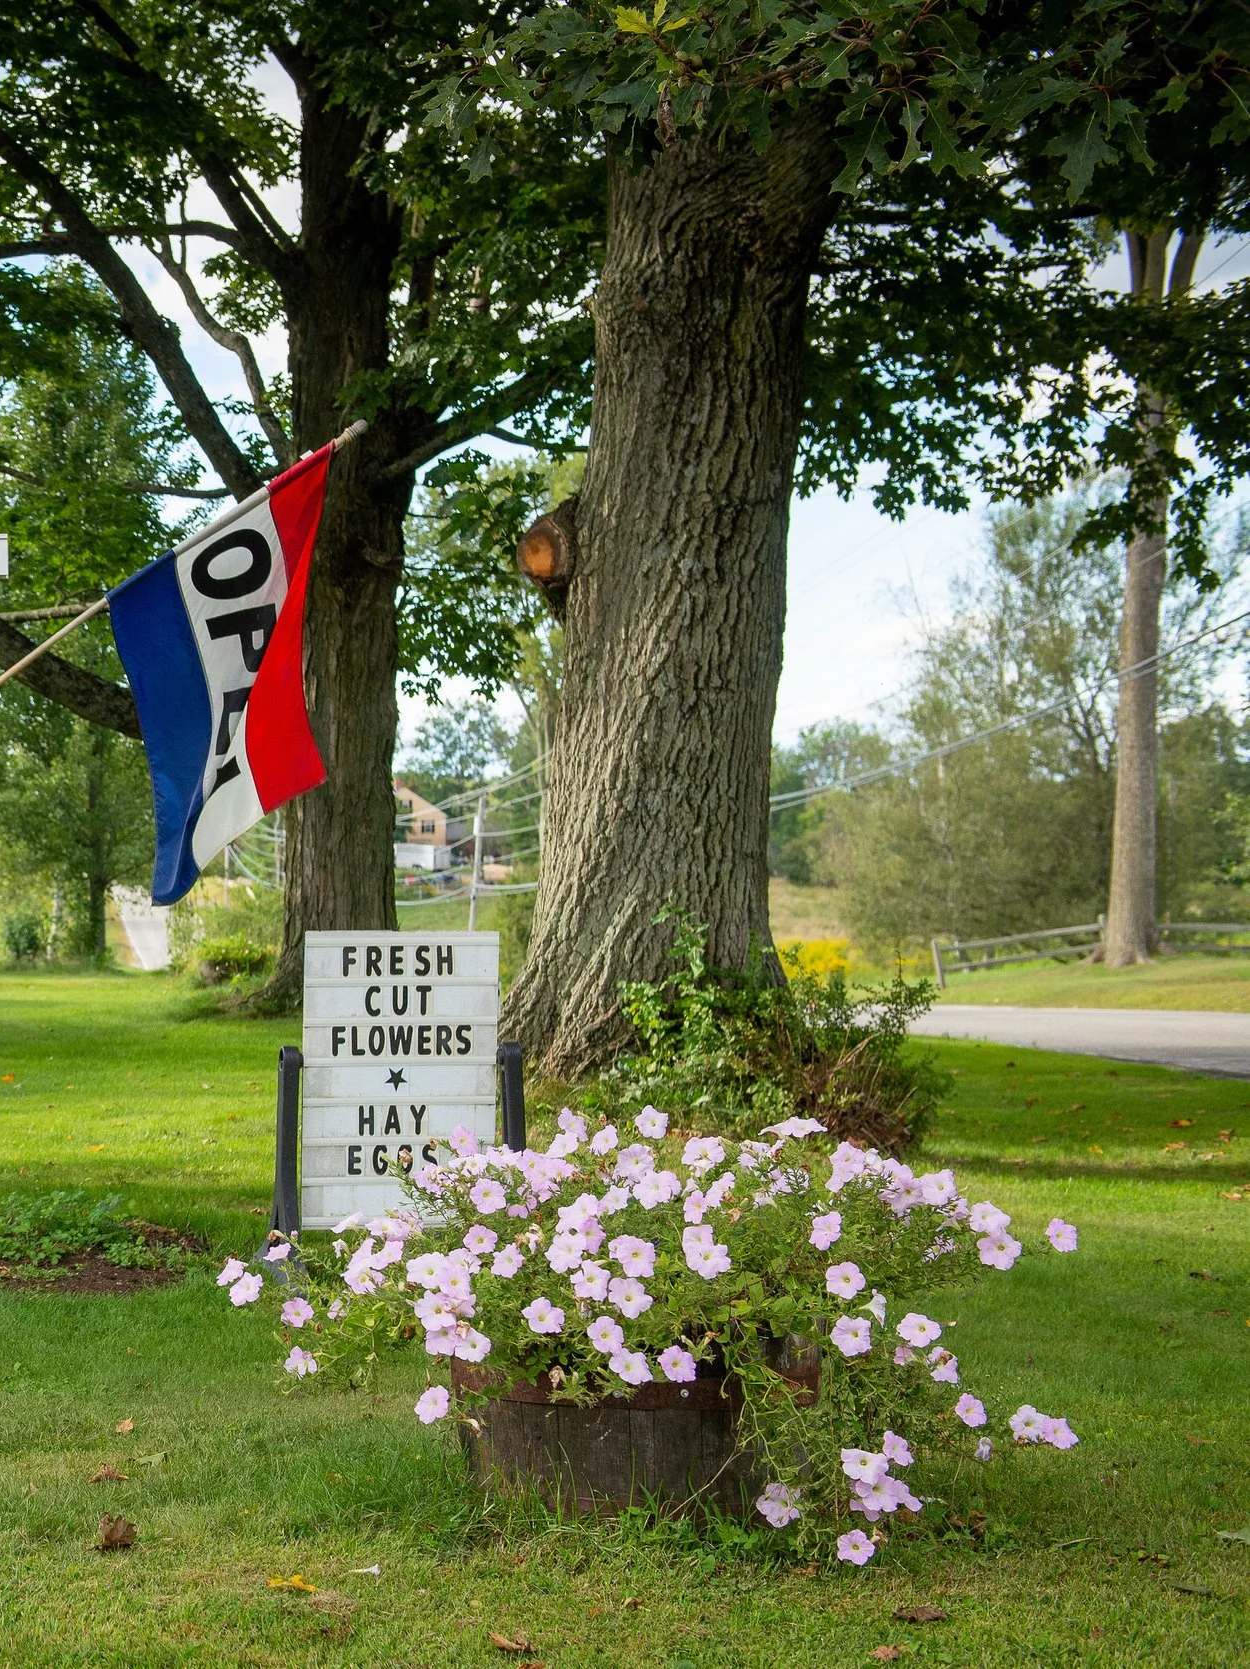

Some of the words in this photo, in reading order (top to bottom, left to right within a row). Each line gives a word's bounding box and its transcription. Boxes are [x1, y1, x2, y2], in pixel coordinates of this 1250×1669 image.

[190, 529, 277, 797] OP
[342, 946, 453, 976] FRESH
[365, 985, 432, 1016] CUT
[332, 1024, 472, 1056] FLOWERS
[359, 1104, 426, 1136] HAY
